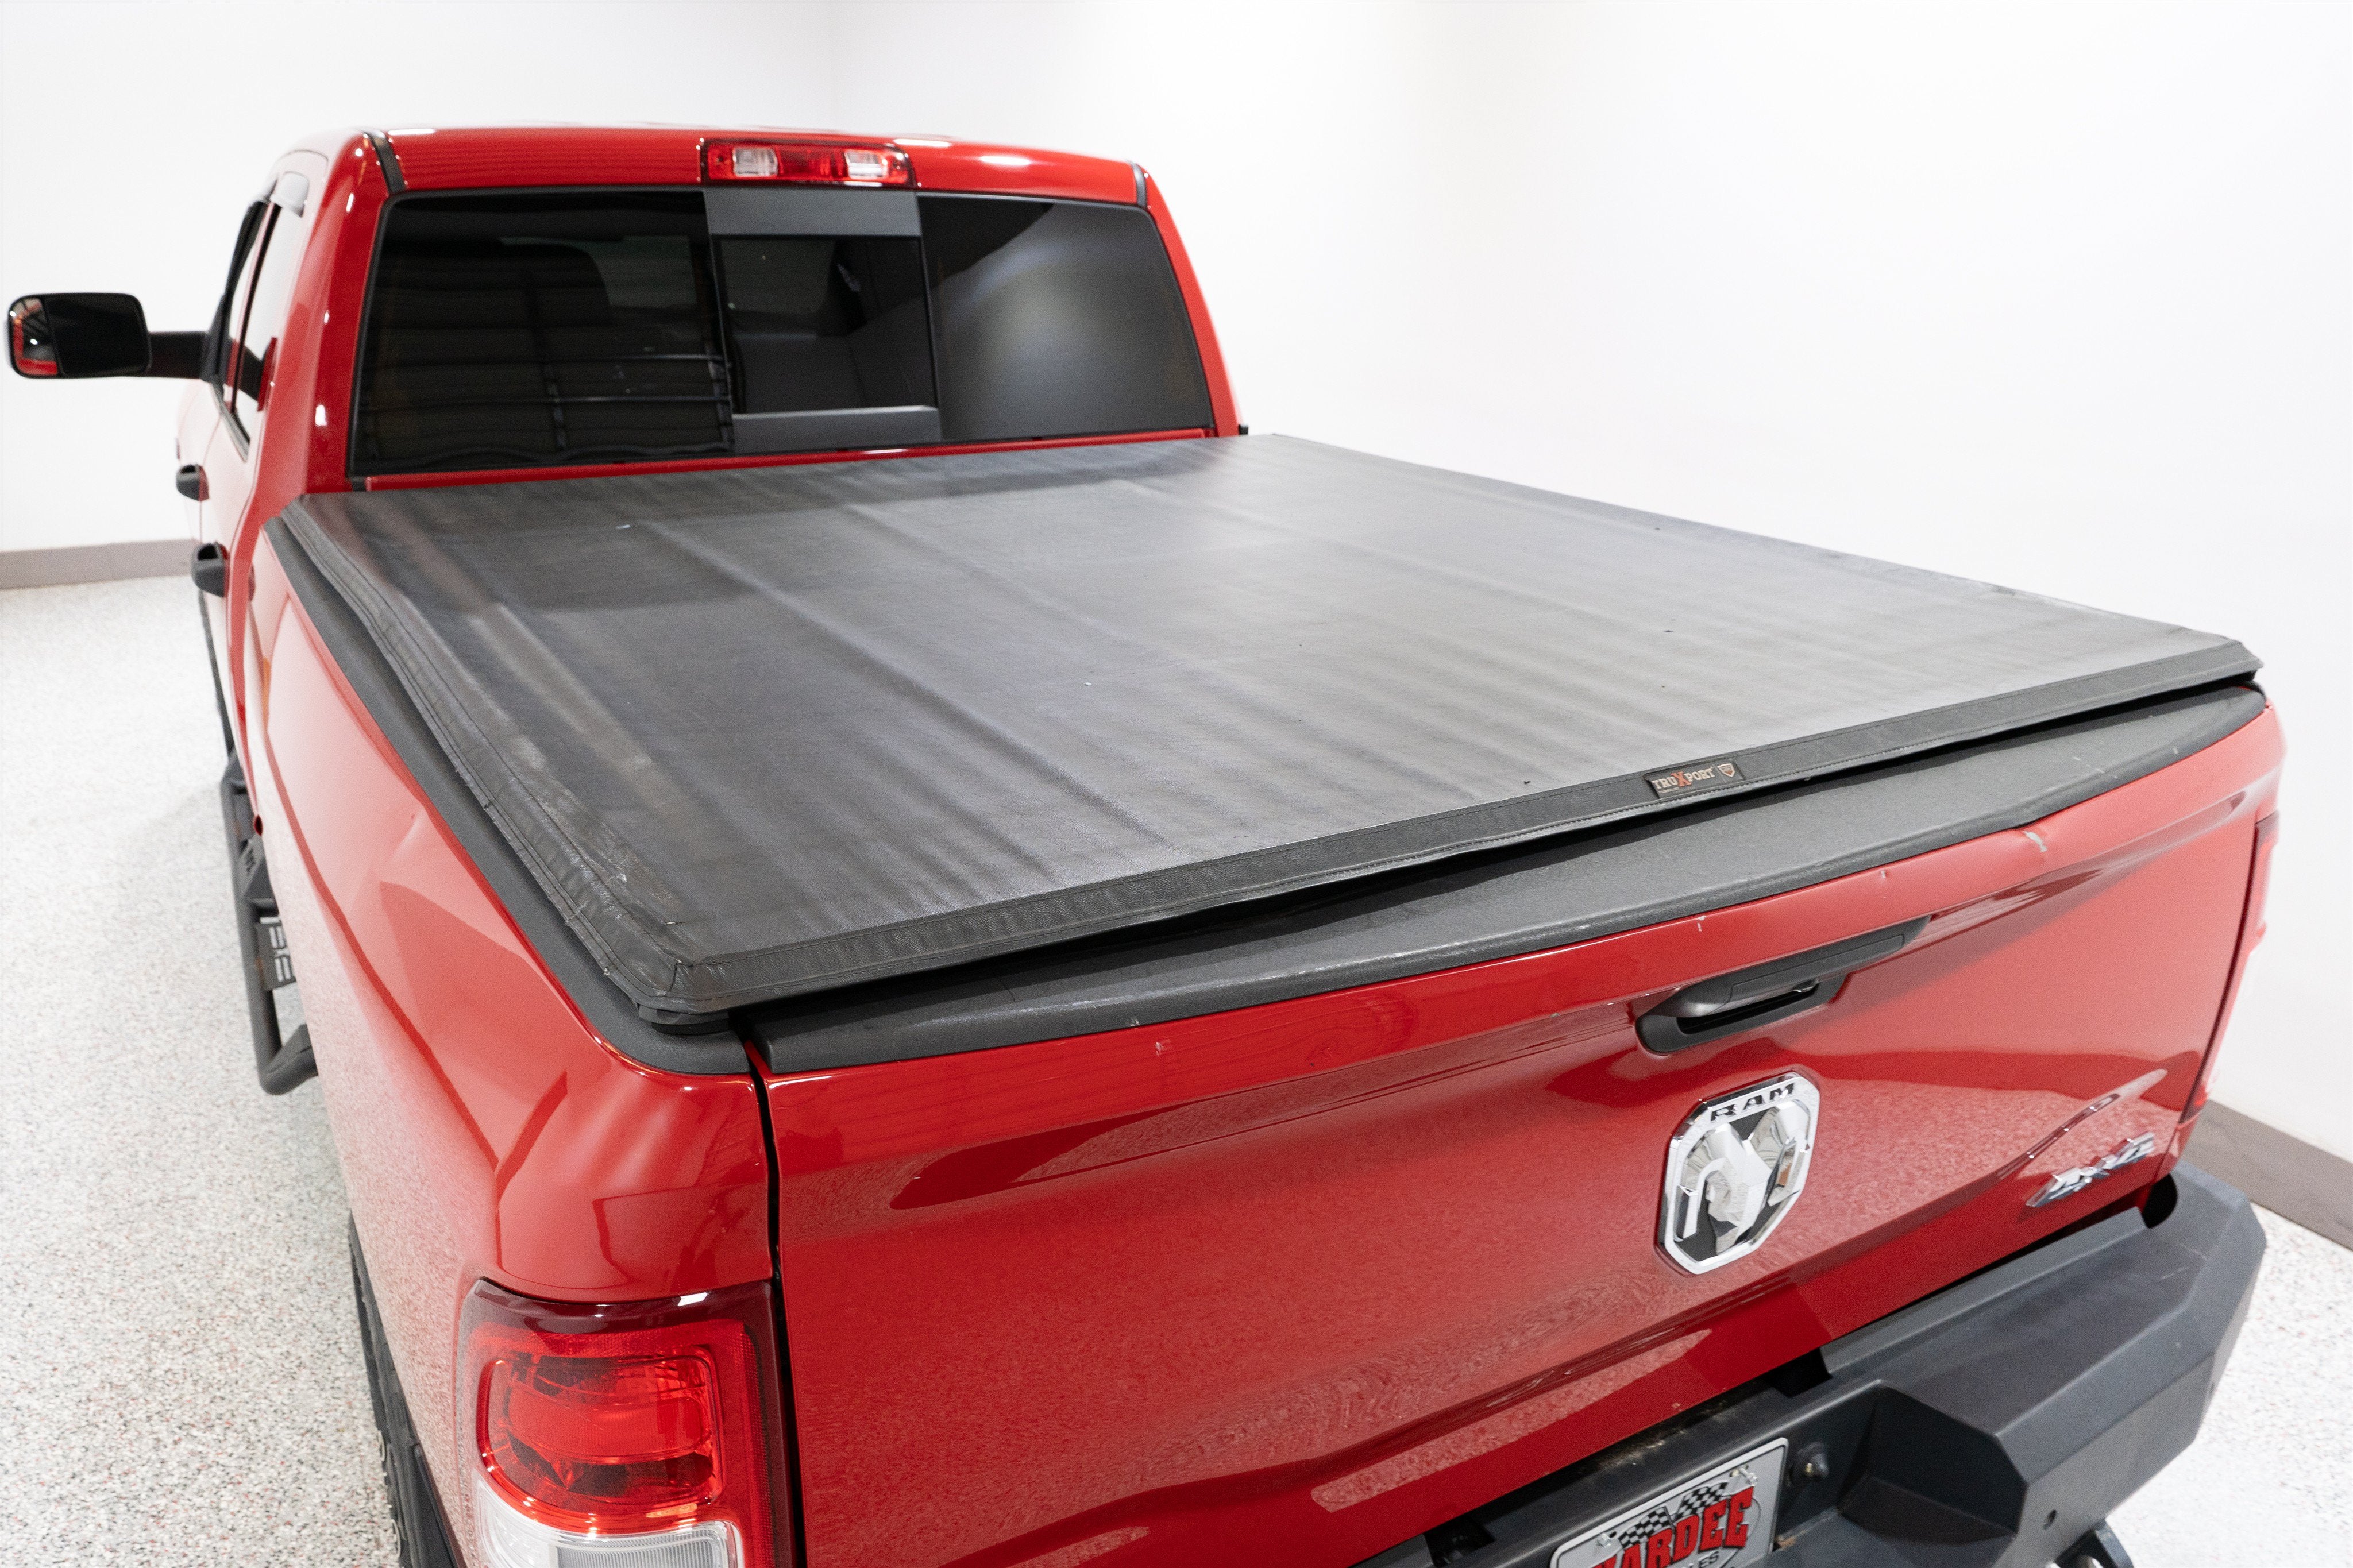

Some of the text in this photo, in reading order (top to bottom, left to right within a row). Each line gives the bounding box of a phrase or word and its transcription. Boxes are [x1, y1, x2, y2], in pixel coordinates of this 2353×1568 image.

[1652, 767, 1715, 789] TRUXPORT
[1711, 1083, 1795, 1121] RAM
[1592, 1486, 1754, 1568] ARDEE
